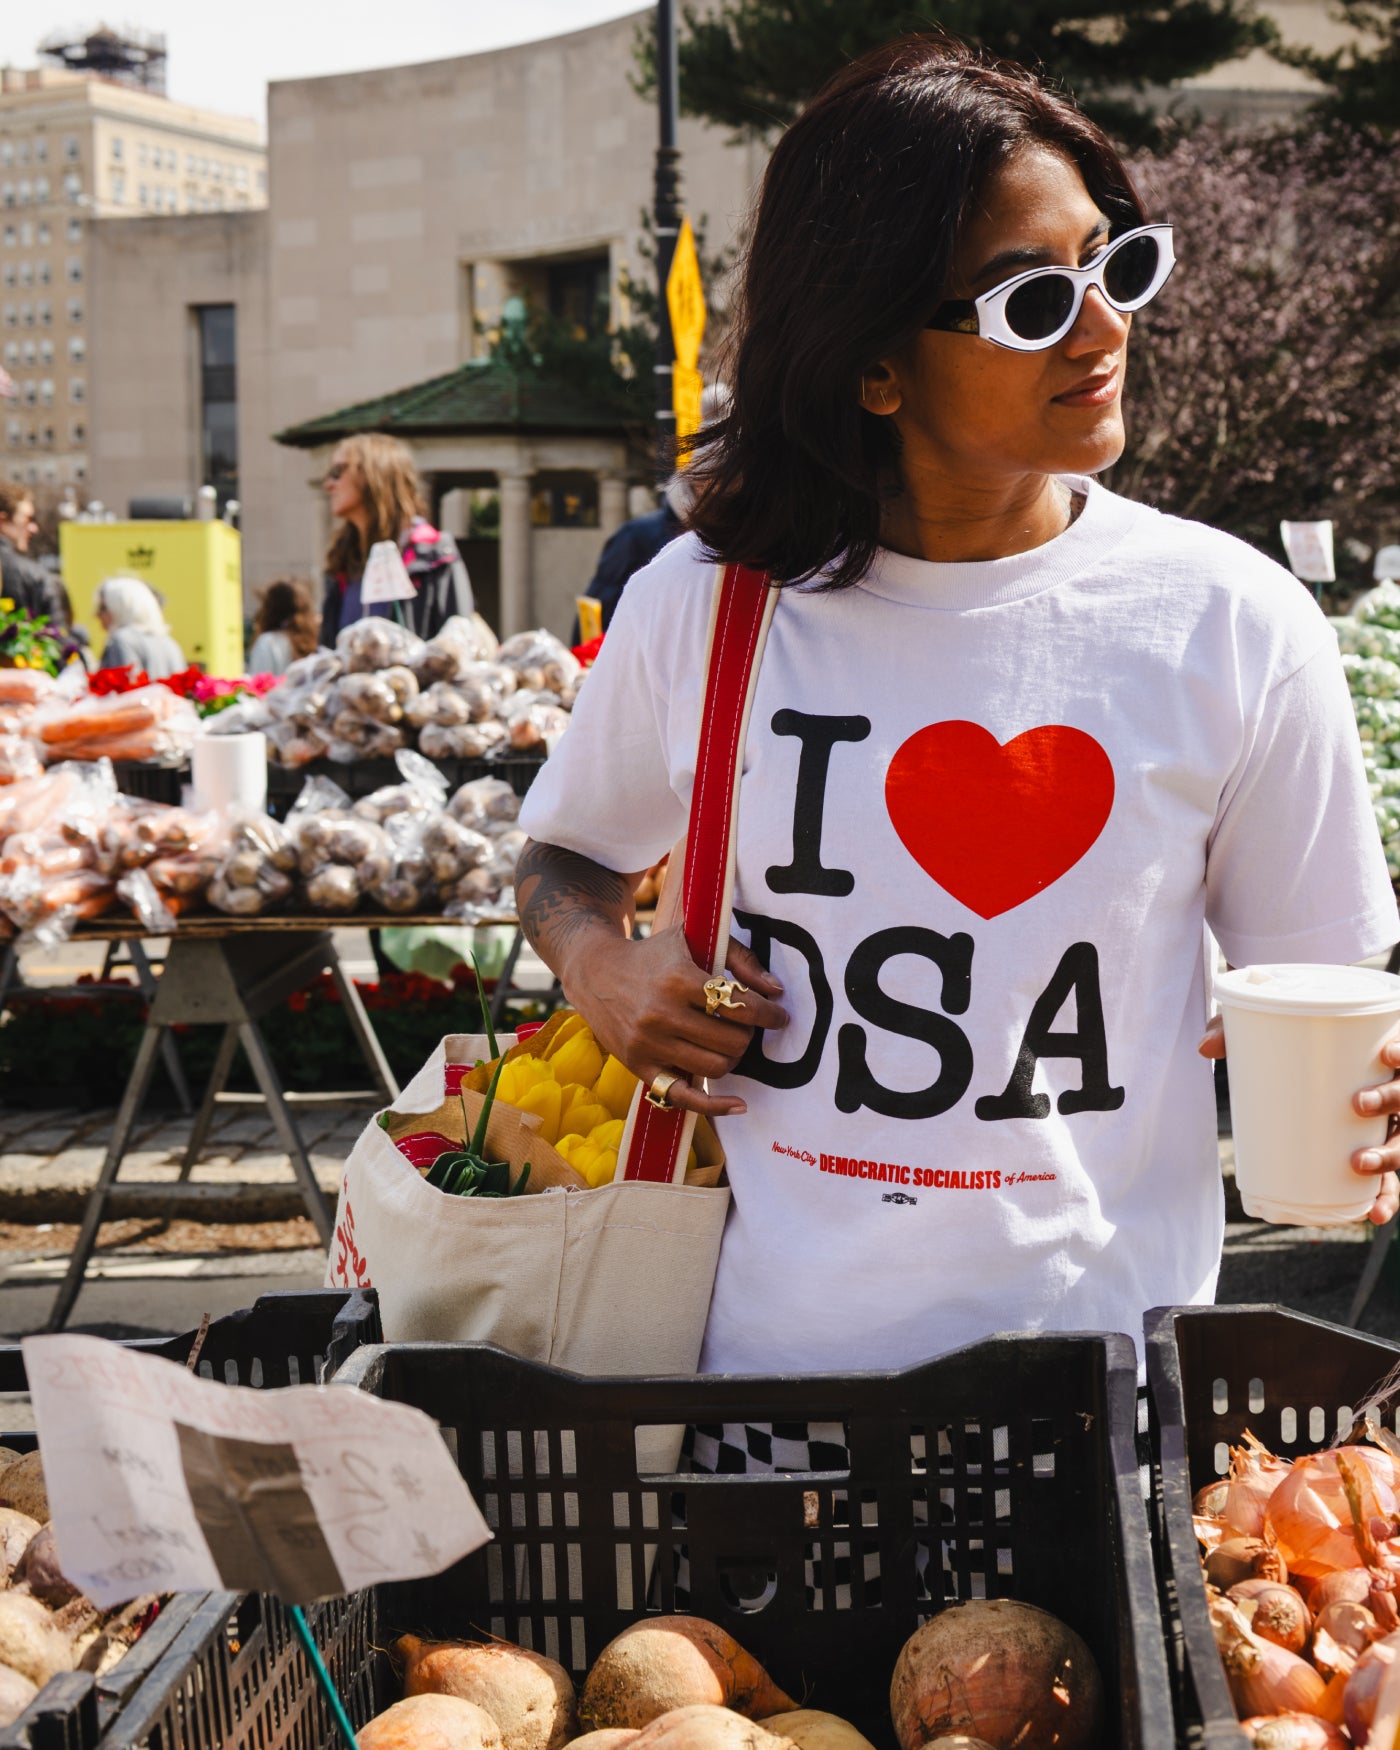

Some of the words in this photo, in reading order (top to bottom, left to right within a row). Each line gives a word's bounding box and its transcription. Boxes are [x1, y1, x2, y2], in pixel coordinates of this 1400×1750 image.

[765, 708, 871, 897] I
[731, 907, 1125, 1120] DSA
[772, 1141, 787, 1154] New
[786, 1145, 801, 1160] York
[801, 1150, 817, 1166] City
[819, 1153, 910, 1185] DEMOCRATIC
[913, 1168, 1001, 1190] SOCIALISTS
[1004, 1173, 1016, 1186] of
[1016, 1171, 1056, 1183] America
